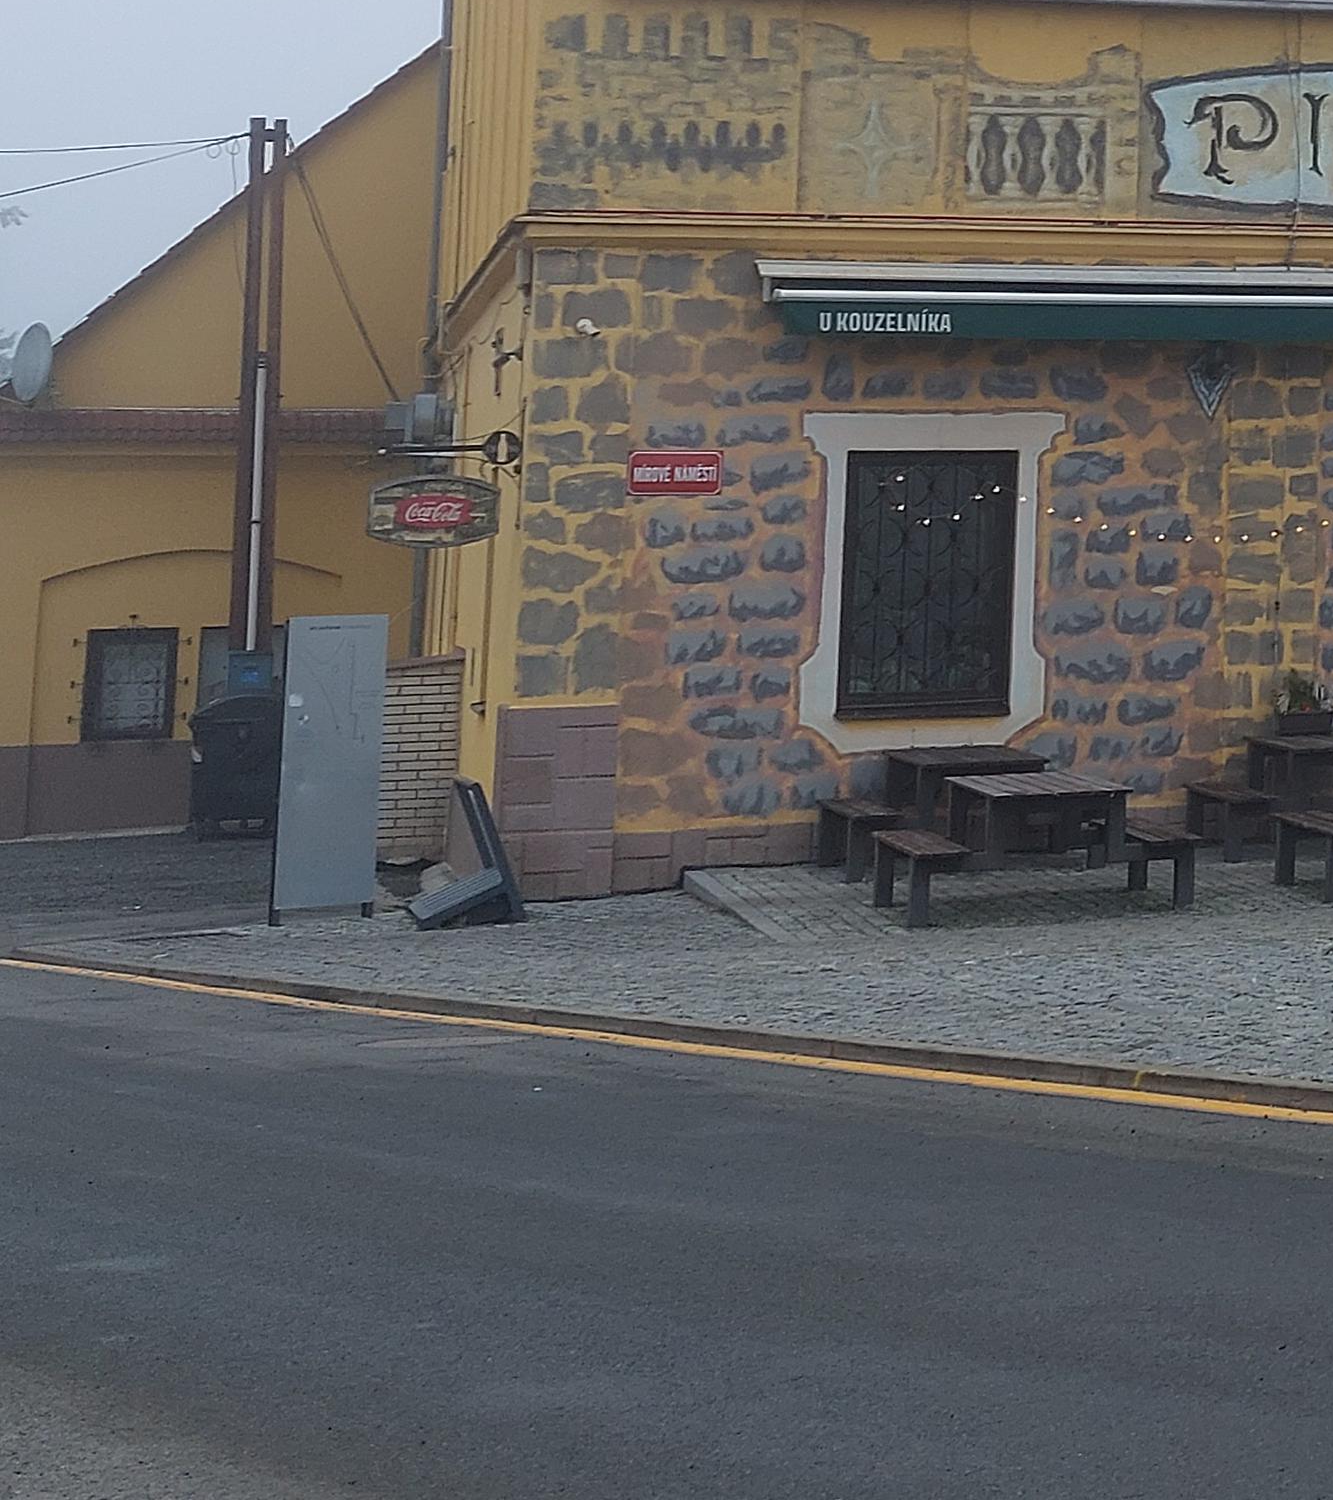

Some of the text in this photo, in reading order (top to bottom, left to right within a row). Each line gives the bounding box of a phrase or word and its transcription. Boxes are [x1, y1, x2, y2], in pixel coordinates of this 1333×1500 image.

[819, 308, 952, 332] U KOUZELNÍKA
[673, 463, 718, 482] NÁMĚSTÍ
[405, 502, 465, 522] Coca-Cola
